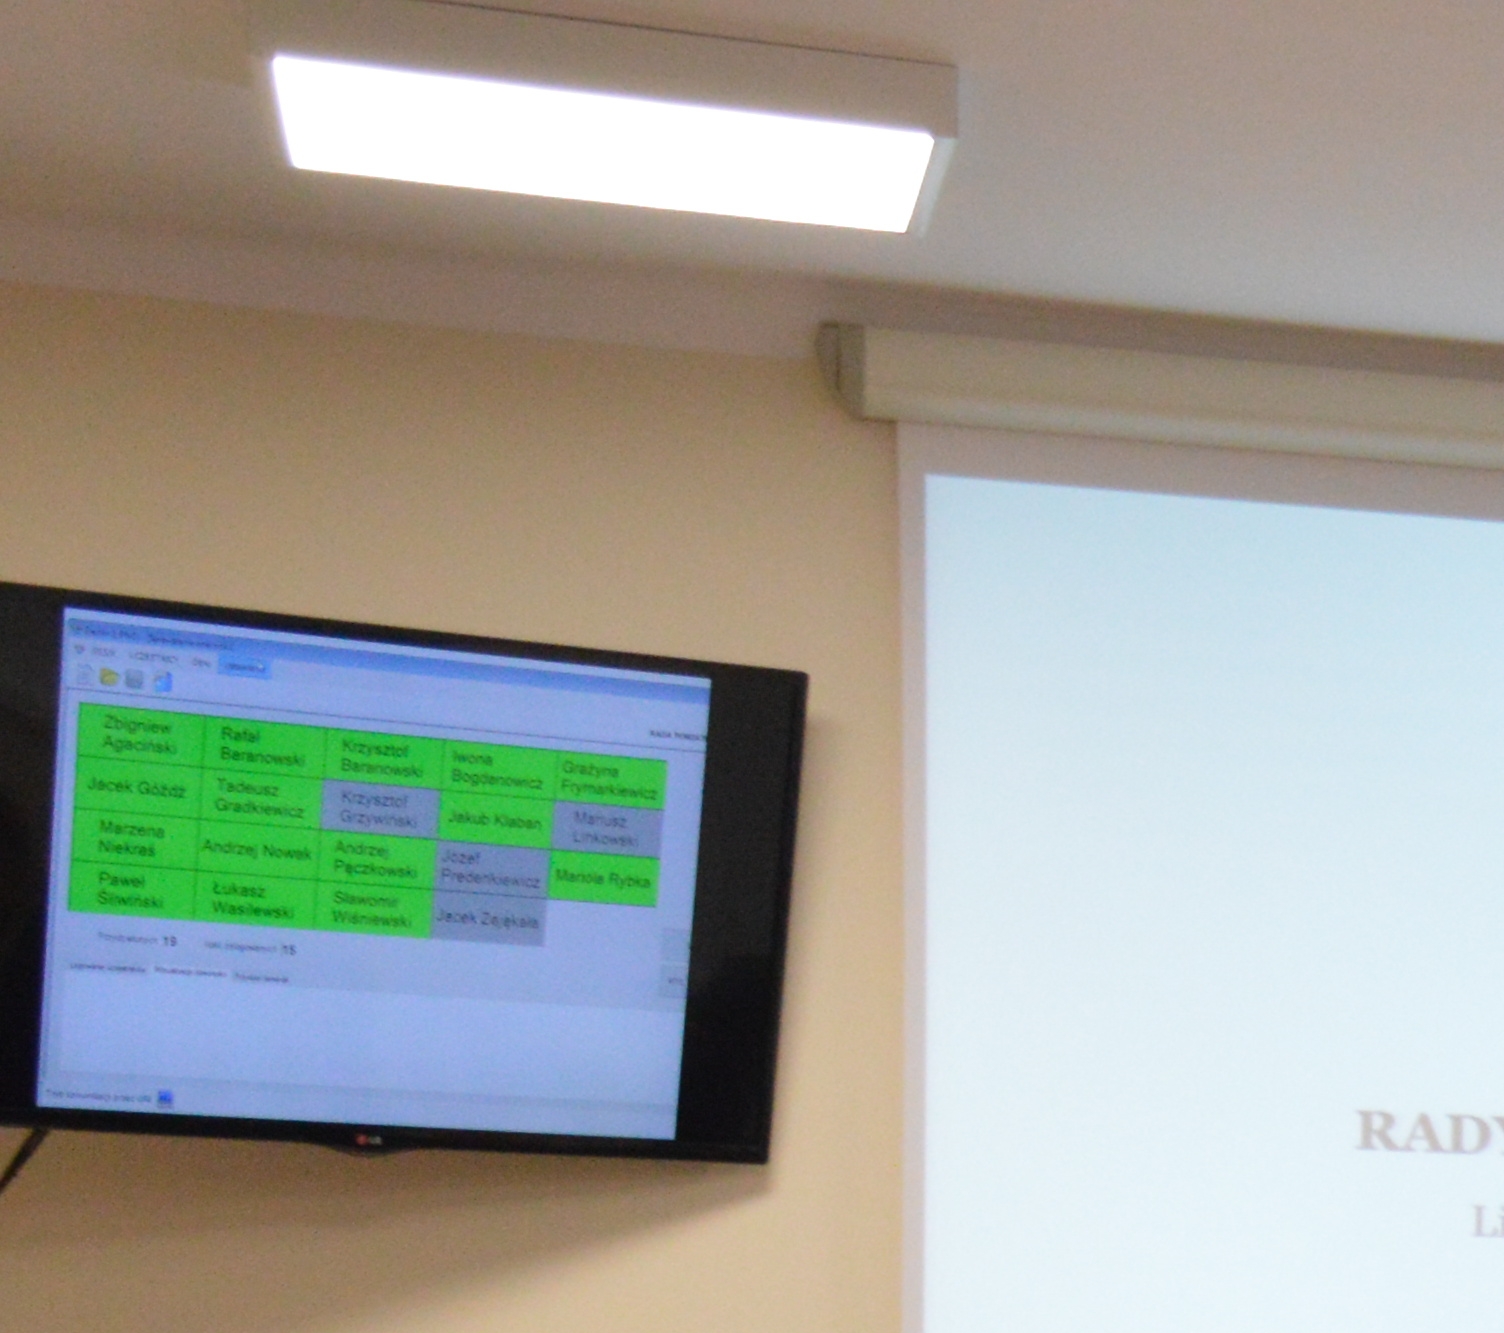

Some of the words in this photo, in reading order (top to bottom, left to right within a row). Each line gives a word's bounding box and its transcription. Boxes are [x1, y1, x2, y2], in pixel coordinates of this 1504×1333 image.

[103, 714, 172, 735] Zbigniew
[219, 746, 305, 767] Baranowski
[341, 738, 409, 759] Krzysztof
[452, 750, 493, 766] Iwona
[340, 758, 423, 778] Baranowski
[87, 777, 133, 794] Jacek
[216, 777, 279, 797] Tadeusz
[451, 768, 543, 790] Bogdanowicz
[340, 790, 408, 811] Krzysztof
[447, 810, 491, 827] Jakub
[100, 819, 164, 839] Marzena
[202, 839, 259, 860] Andrzej
[335, 840, 389, 860] Andrzej
[212, 881, 267, 899] Łukasz
[212, 899, 294, 919] Wasilewski
